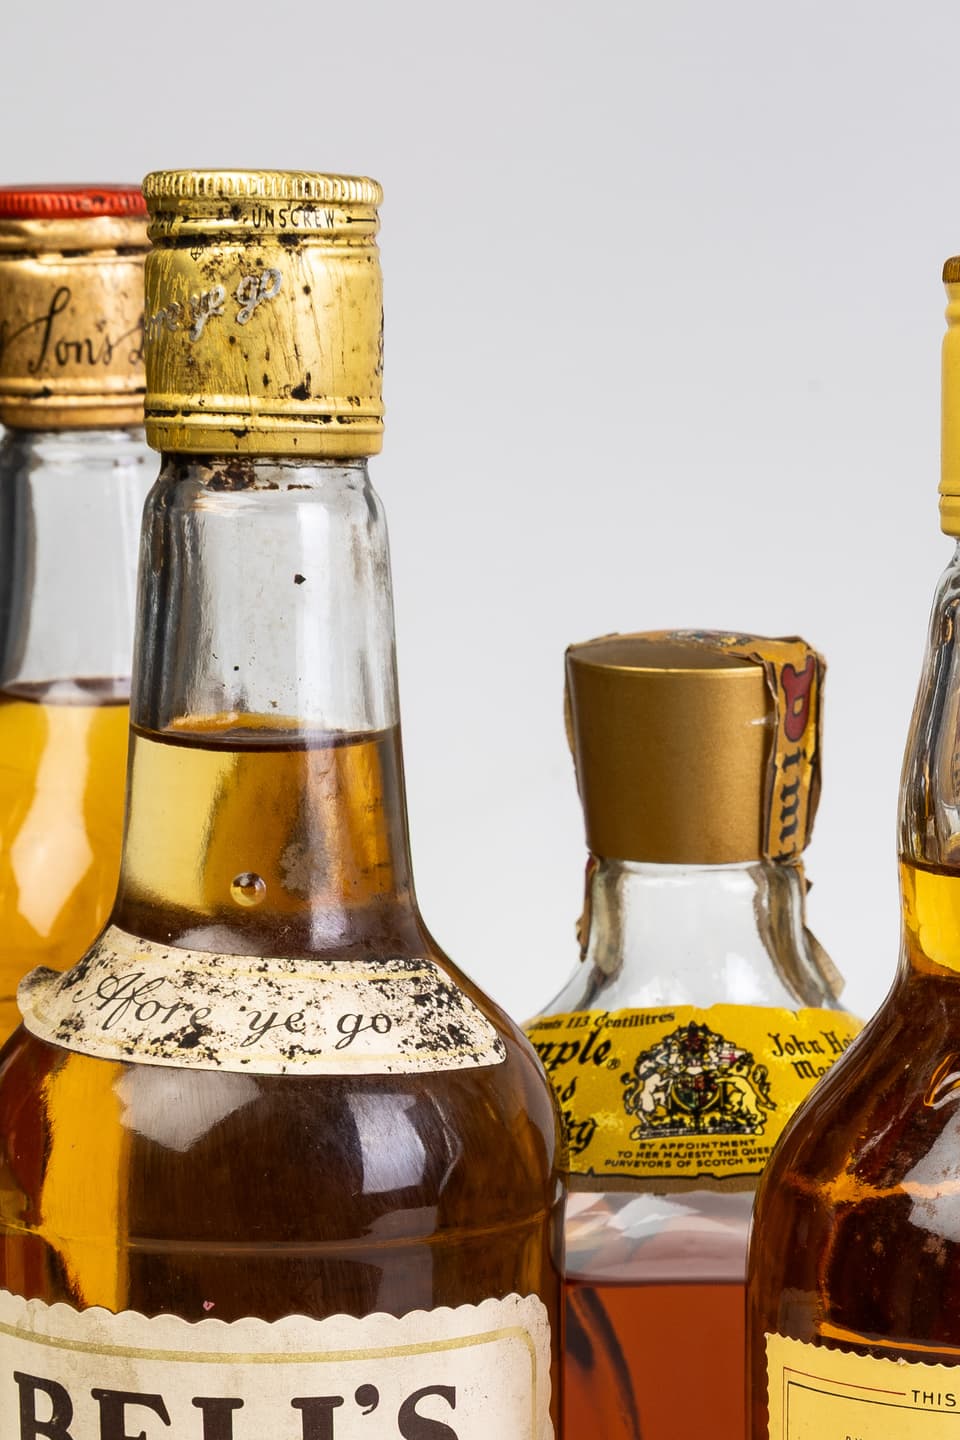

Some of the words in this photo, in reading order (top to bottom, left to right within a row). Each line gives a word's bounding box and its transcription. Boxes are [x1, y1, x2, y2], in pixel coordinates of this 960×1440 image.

[251, 207, 336, 230] UNSCREW
[10, 286, 114, 375] Sons
[240, 1007, 307, 1049] ye
[335, 1012, 393, 1051] go
[566, 1015, 590, 1029] 113
[593, 1011, 676, 1029] Centilitres
[767, 1031, 826, 1057] John
[617, 1150, 633, 1159] TO
[636, 1151, 660, 1159] HER
[663, 1150, 714, 1159] MAJESTY
[717, 1148, 739, 1158] THE
[743, 1146, 775, 1156] QUEE
[639, 1142, 655, 1150] BY
[660, 1138, 757, 1150] APPOINTMENT
[604, 1158, 672, 1169] PURVEYORS
[676, 1158, 692, 1168] OF
[696, 1157, 744, 1168] SCOTCH
[911, 1389, 957, 1408] THIS
